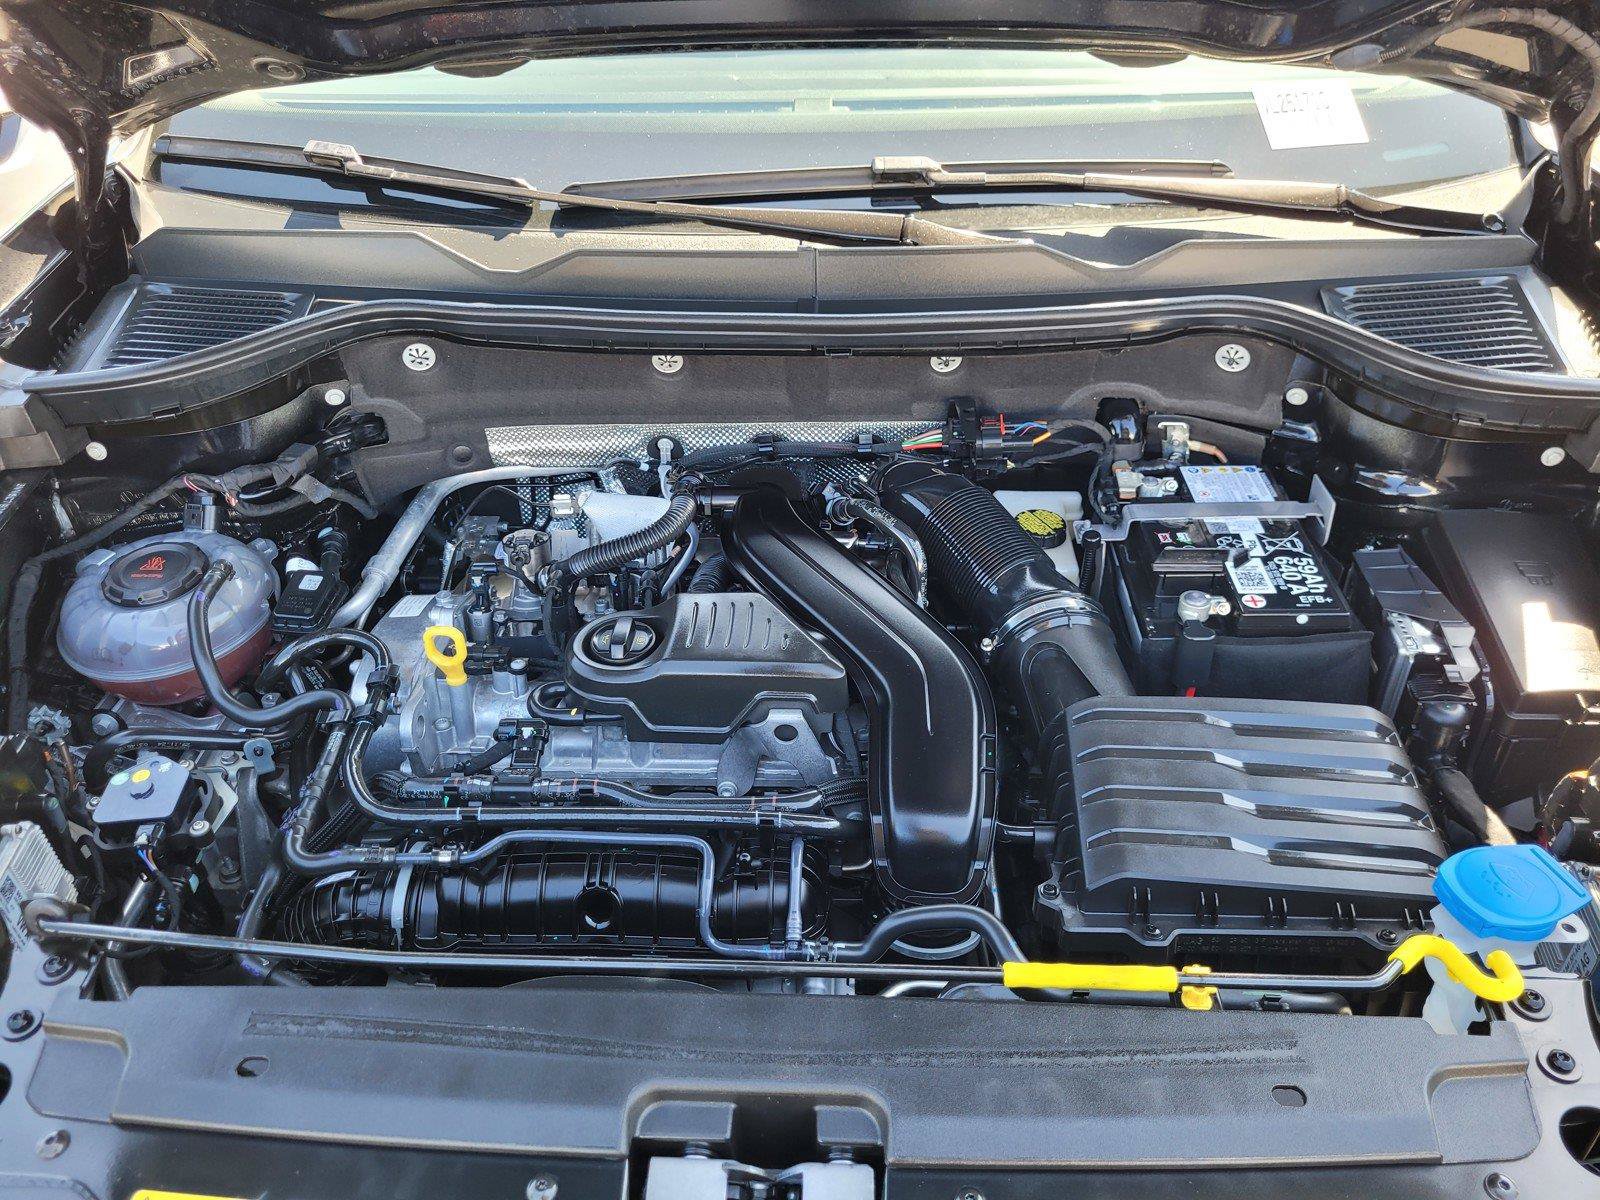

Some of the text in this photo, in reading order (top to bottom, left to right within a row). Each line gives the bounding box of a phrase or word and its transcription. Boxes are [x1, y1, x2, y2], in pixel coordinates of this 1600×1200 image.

[1273, 556, 1302, 581] 640
[1293, 557, 1328, 593] 59Ah
[1286, 584, 1310, 596] A
[1299, 595, 1333, 604] EFB+
